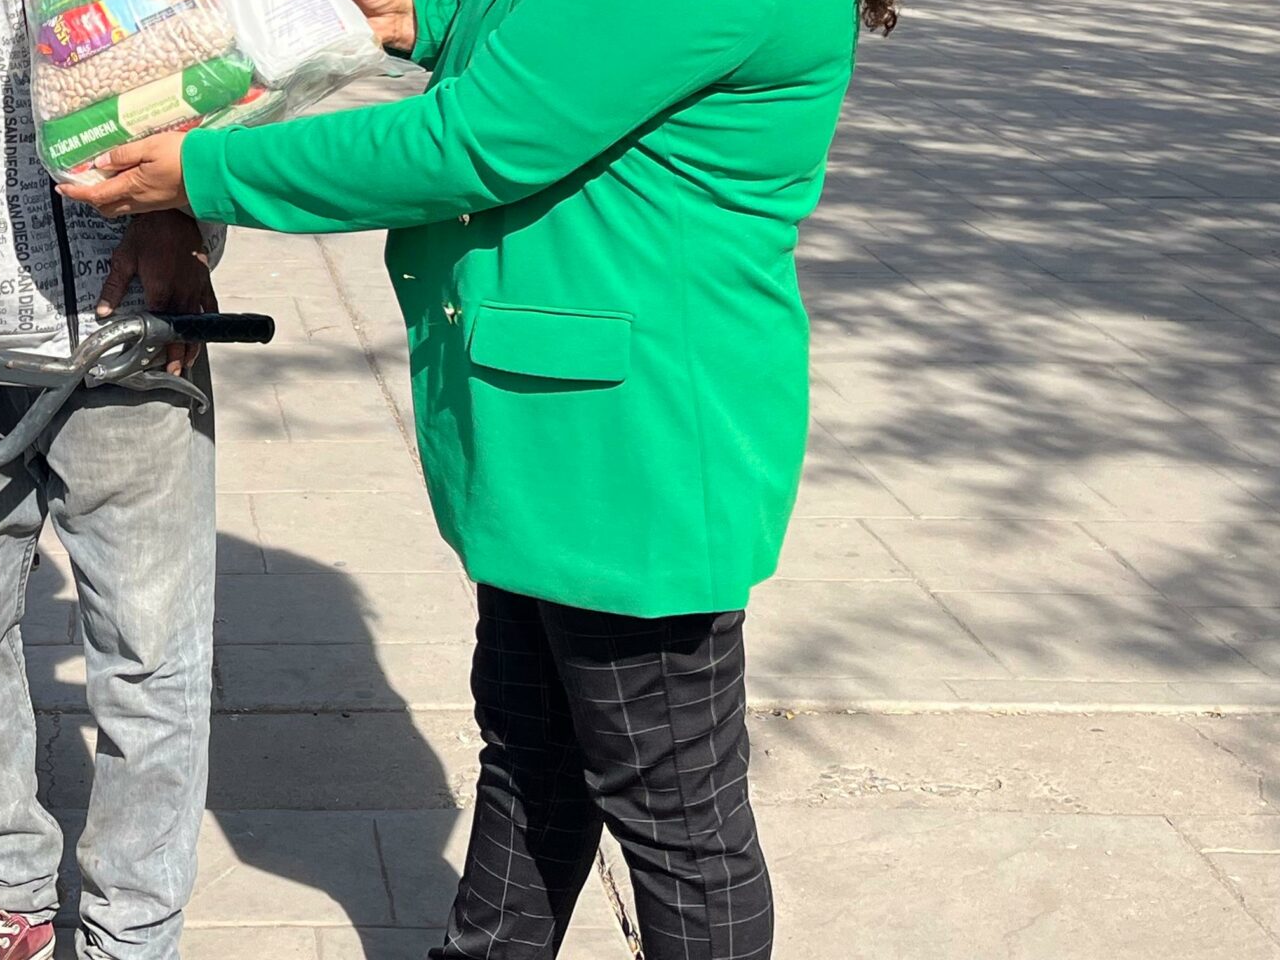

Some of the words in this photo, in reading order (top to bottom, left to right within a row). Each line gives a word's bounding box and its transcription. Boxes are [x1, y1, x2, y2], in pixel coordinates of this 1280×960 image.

[0, 74, 16, 114] DIEGO
[5, 118, 18, 144] SAN
[49, 136, 82, 159] AZÚCAR
[79, 119, 119, 145] MORENA
[4, 148, 19, 188] DIEGO
[20, 180, 38, 191] Santa
[6, 194, 22, 220] SAN
[12, 221, 30, 262] DIEGO
[18, 264, 33, 292] SAN
[18, 294, 35, 331] DIEGO
